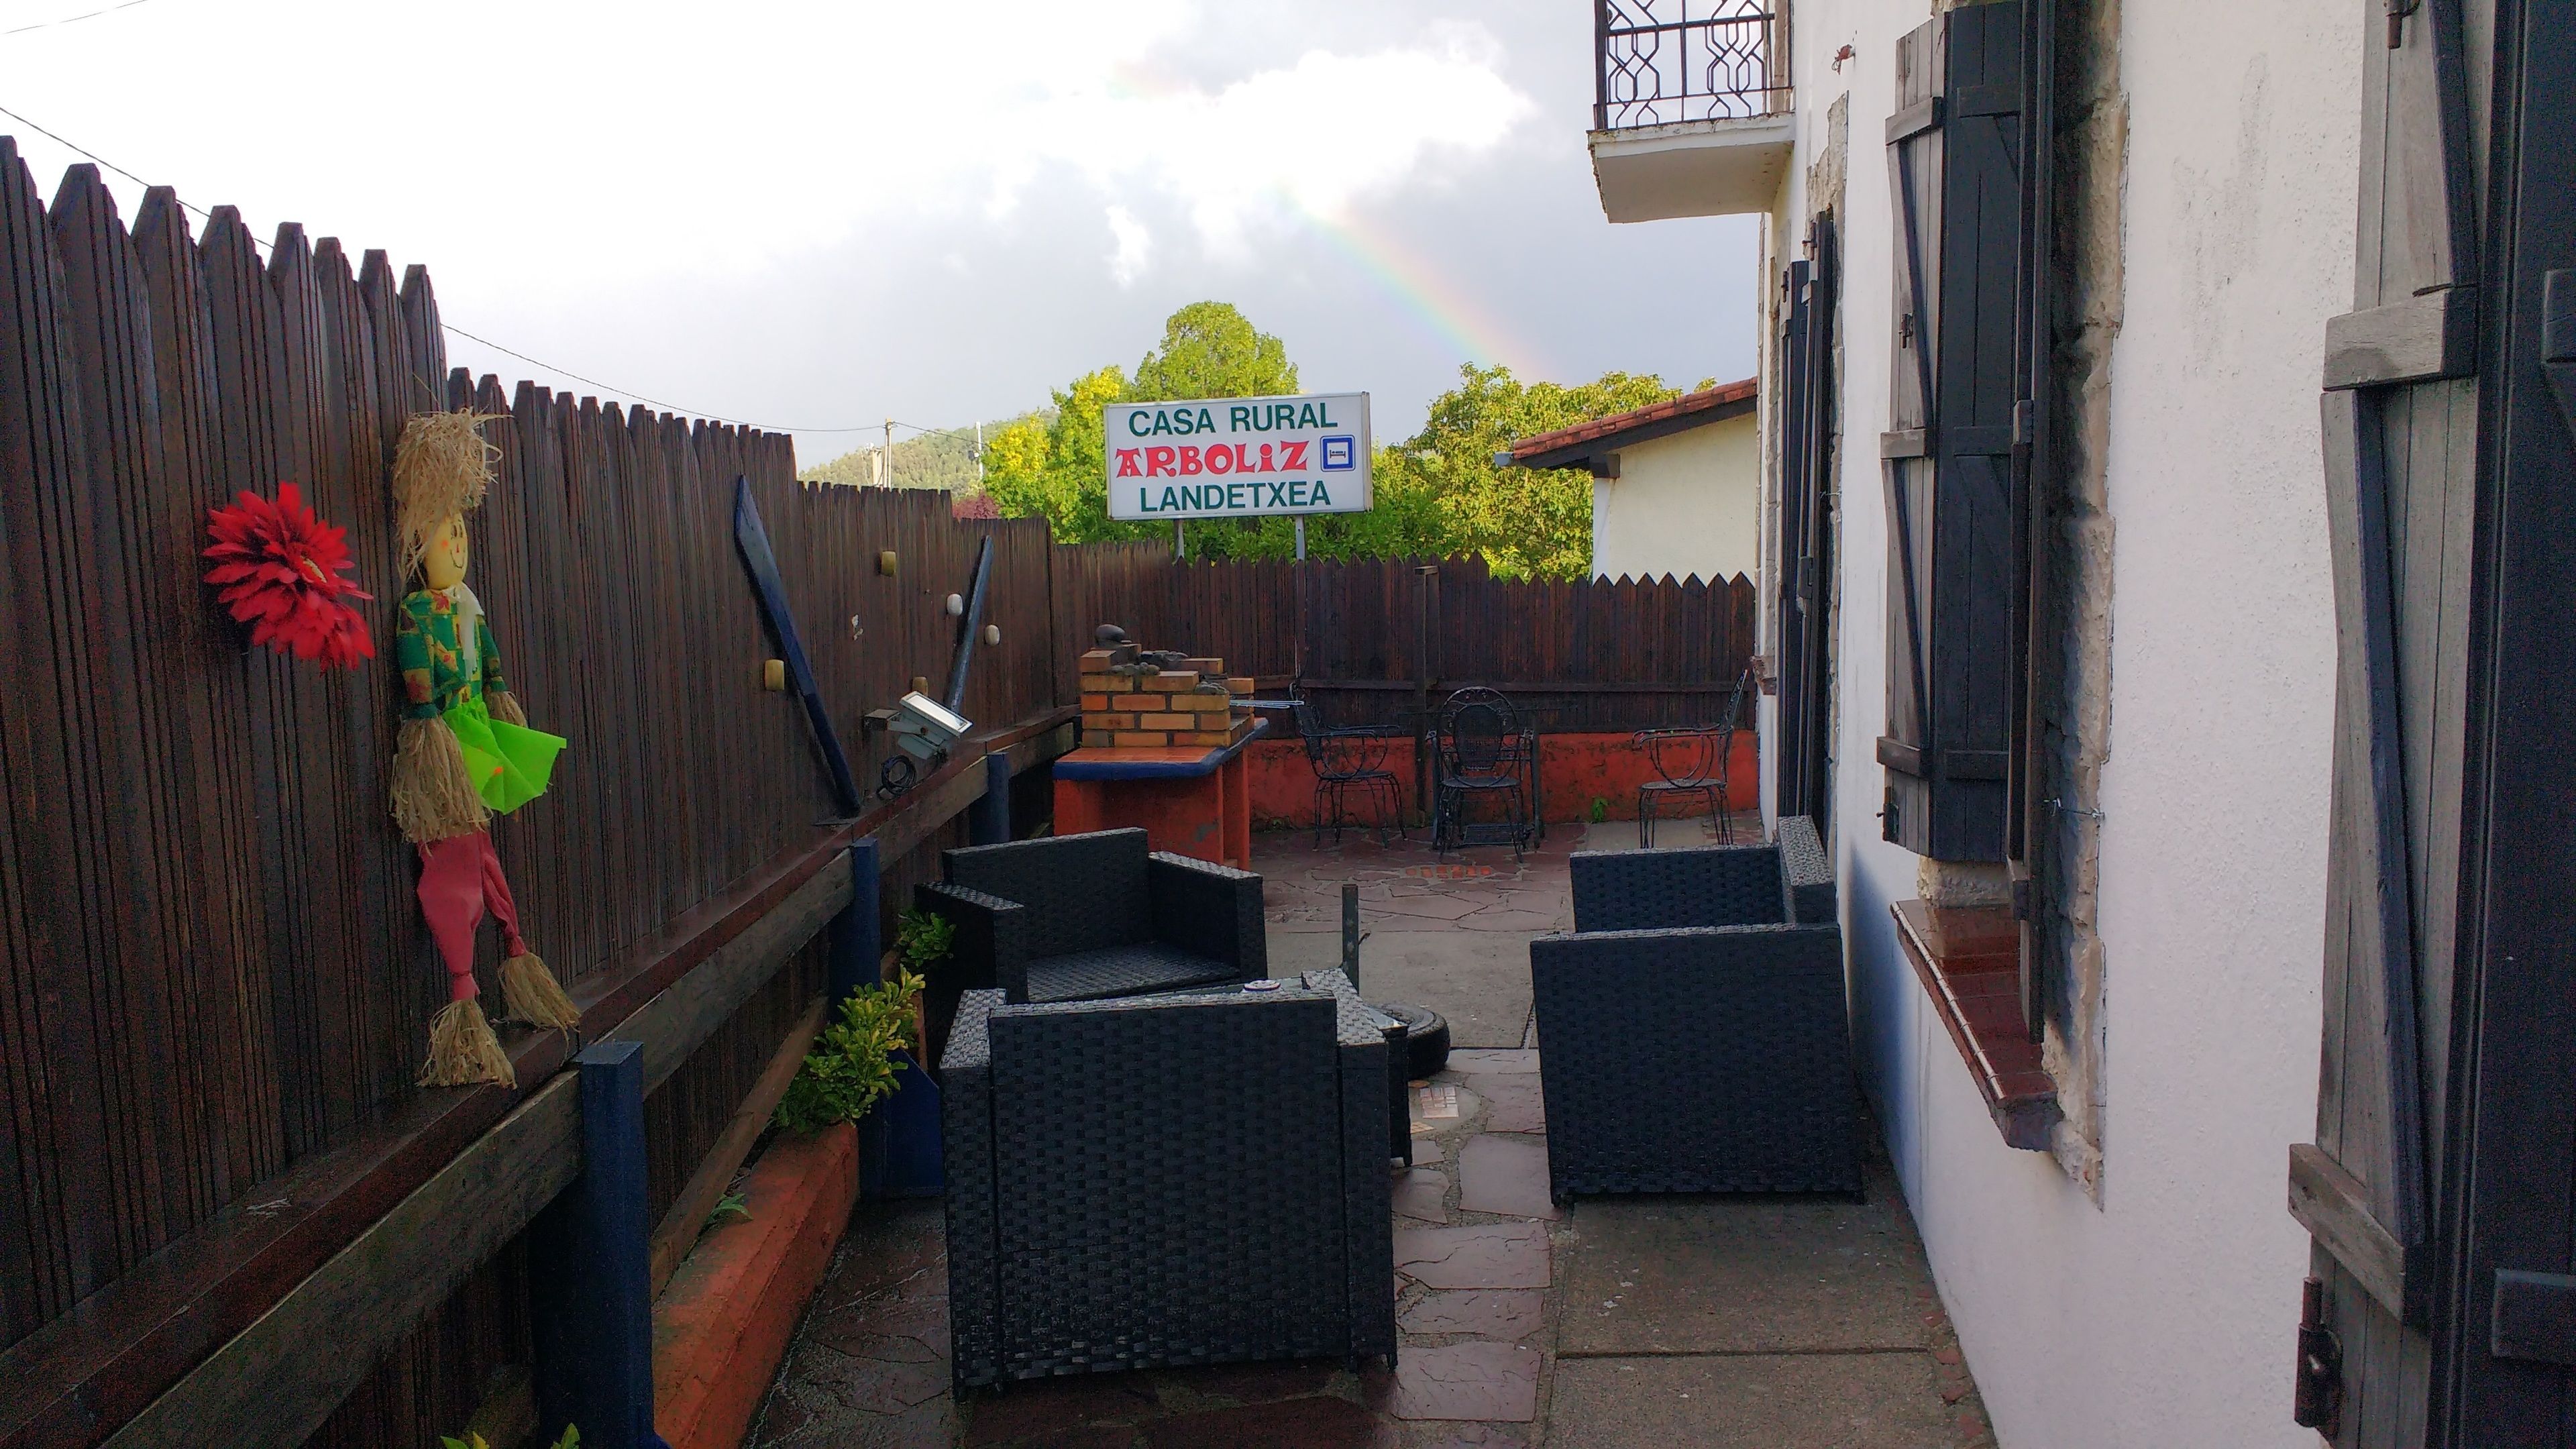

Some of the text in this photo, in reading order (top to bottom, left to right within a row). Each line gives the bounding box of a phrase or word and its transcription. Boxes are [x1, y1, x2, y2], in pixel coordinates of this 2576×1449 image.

[1128, 402, 1338, 437] CASA RURAL
[1140, 480, 1331, 512] LANDETXEA
